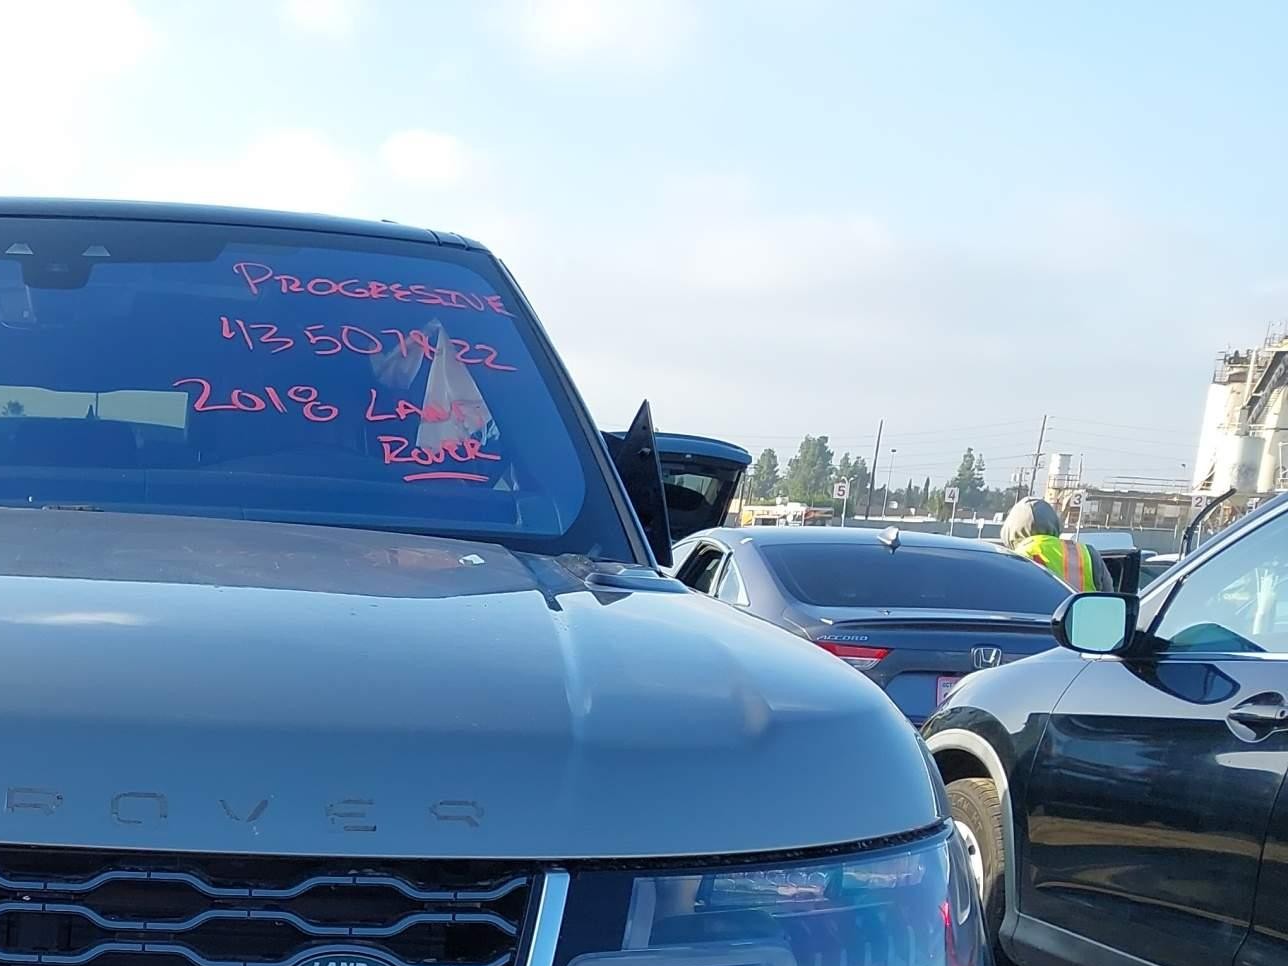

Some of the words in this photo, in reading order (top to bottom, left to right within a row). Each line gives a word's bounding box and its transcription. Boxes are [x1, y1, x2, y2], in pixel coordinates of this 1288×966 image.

[172, 377, 339, 422] 2018
[836, 485, 846, 497] 5
[947, 490, 956, 499] 4
[1074, 493, 1082, 505] 3
[1194, 496, 1203, 508] 2
[4, 787, 485, 832] ROVER
